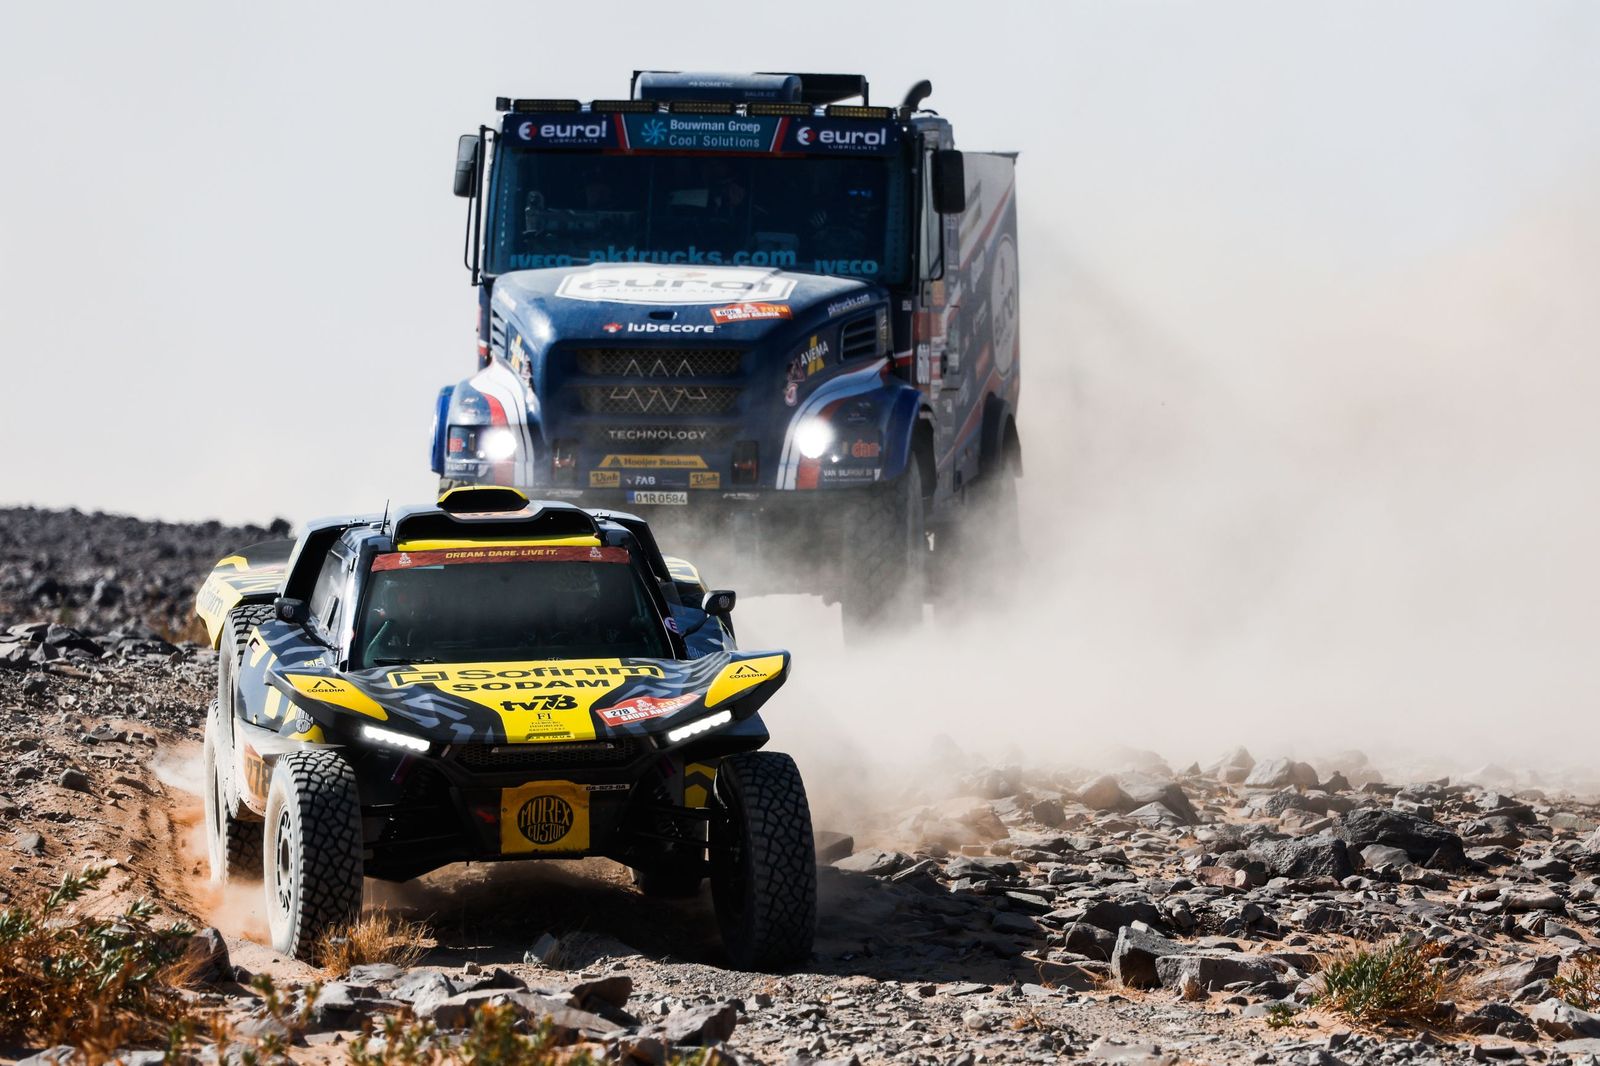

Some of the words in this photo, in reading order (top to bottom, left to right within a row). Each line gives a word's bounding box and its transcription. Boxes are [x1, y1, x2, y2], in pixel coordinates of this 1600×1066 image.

[541, 121, 606, 138] eurol
[670, 119, 725, 132] Bouwman
[728, 121, 761, 133] Groep
[669, 135, 696, 146] Cool
[703, 135, 760, 148] Solutions
[819, 128, 886, 145] eurol
[510, 254, 572, 268] IVECO
[814, 259, 878, 274] IVECO
[627, 322, 715, 333] lubecore
[801, 341, 829, 367] AVEMA
[609, 429, 707, 440] TECHNOLOGY
[635, 476, 656, 485] FAB
[659, 494, 685, 504] 0584
[445, 551, 486, 559] DREAM.
[488, 550, 520, 558] DARE.
[521, 549, 545, 557] LIVE
[456, 665, 660, 681] Sofinim
[452, 679, 611, 692] SODAM
[610, 708, 630, 717] 278
[621, 712, 649, 721] SAUDI
[520, 797, 570, 829] MOREX
[528, 821, 565, 843] CUSTOM
